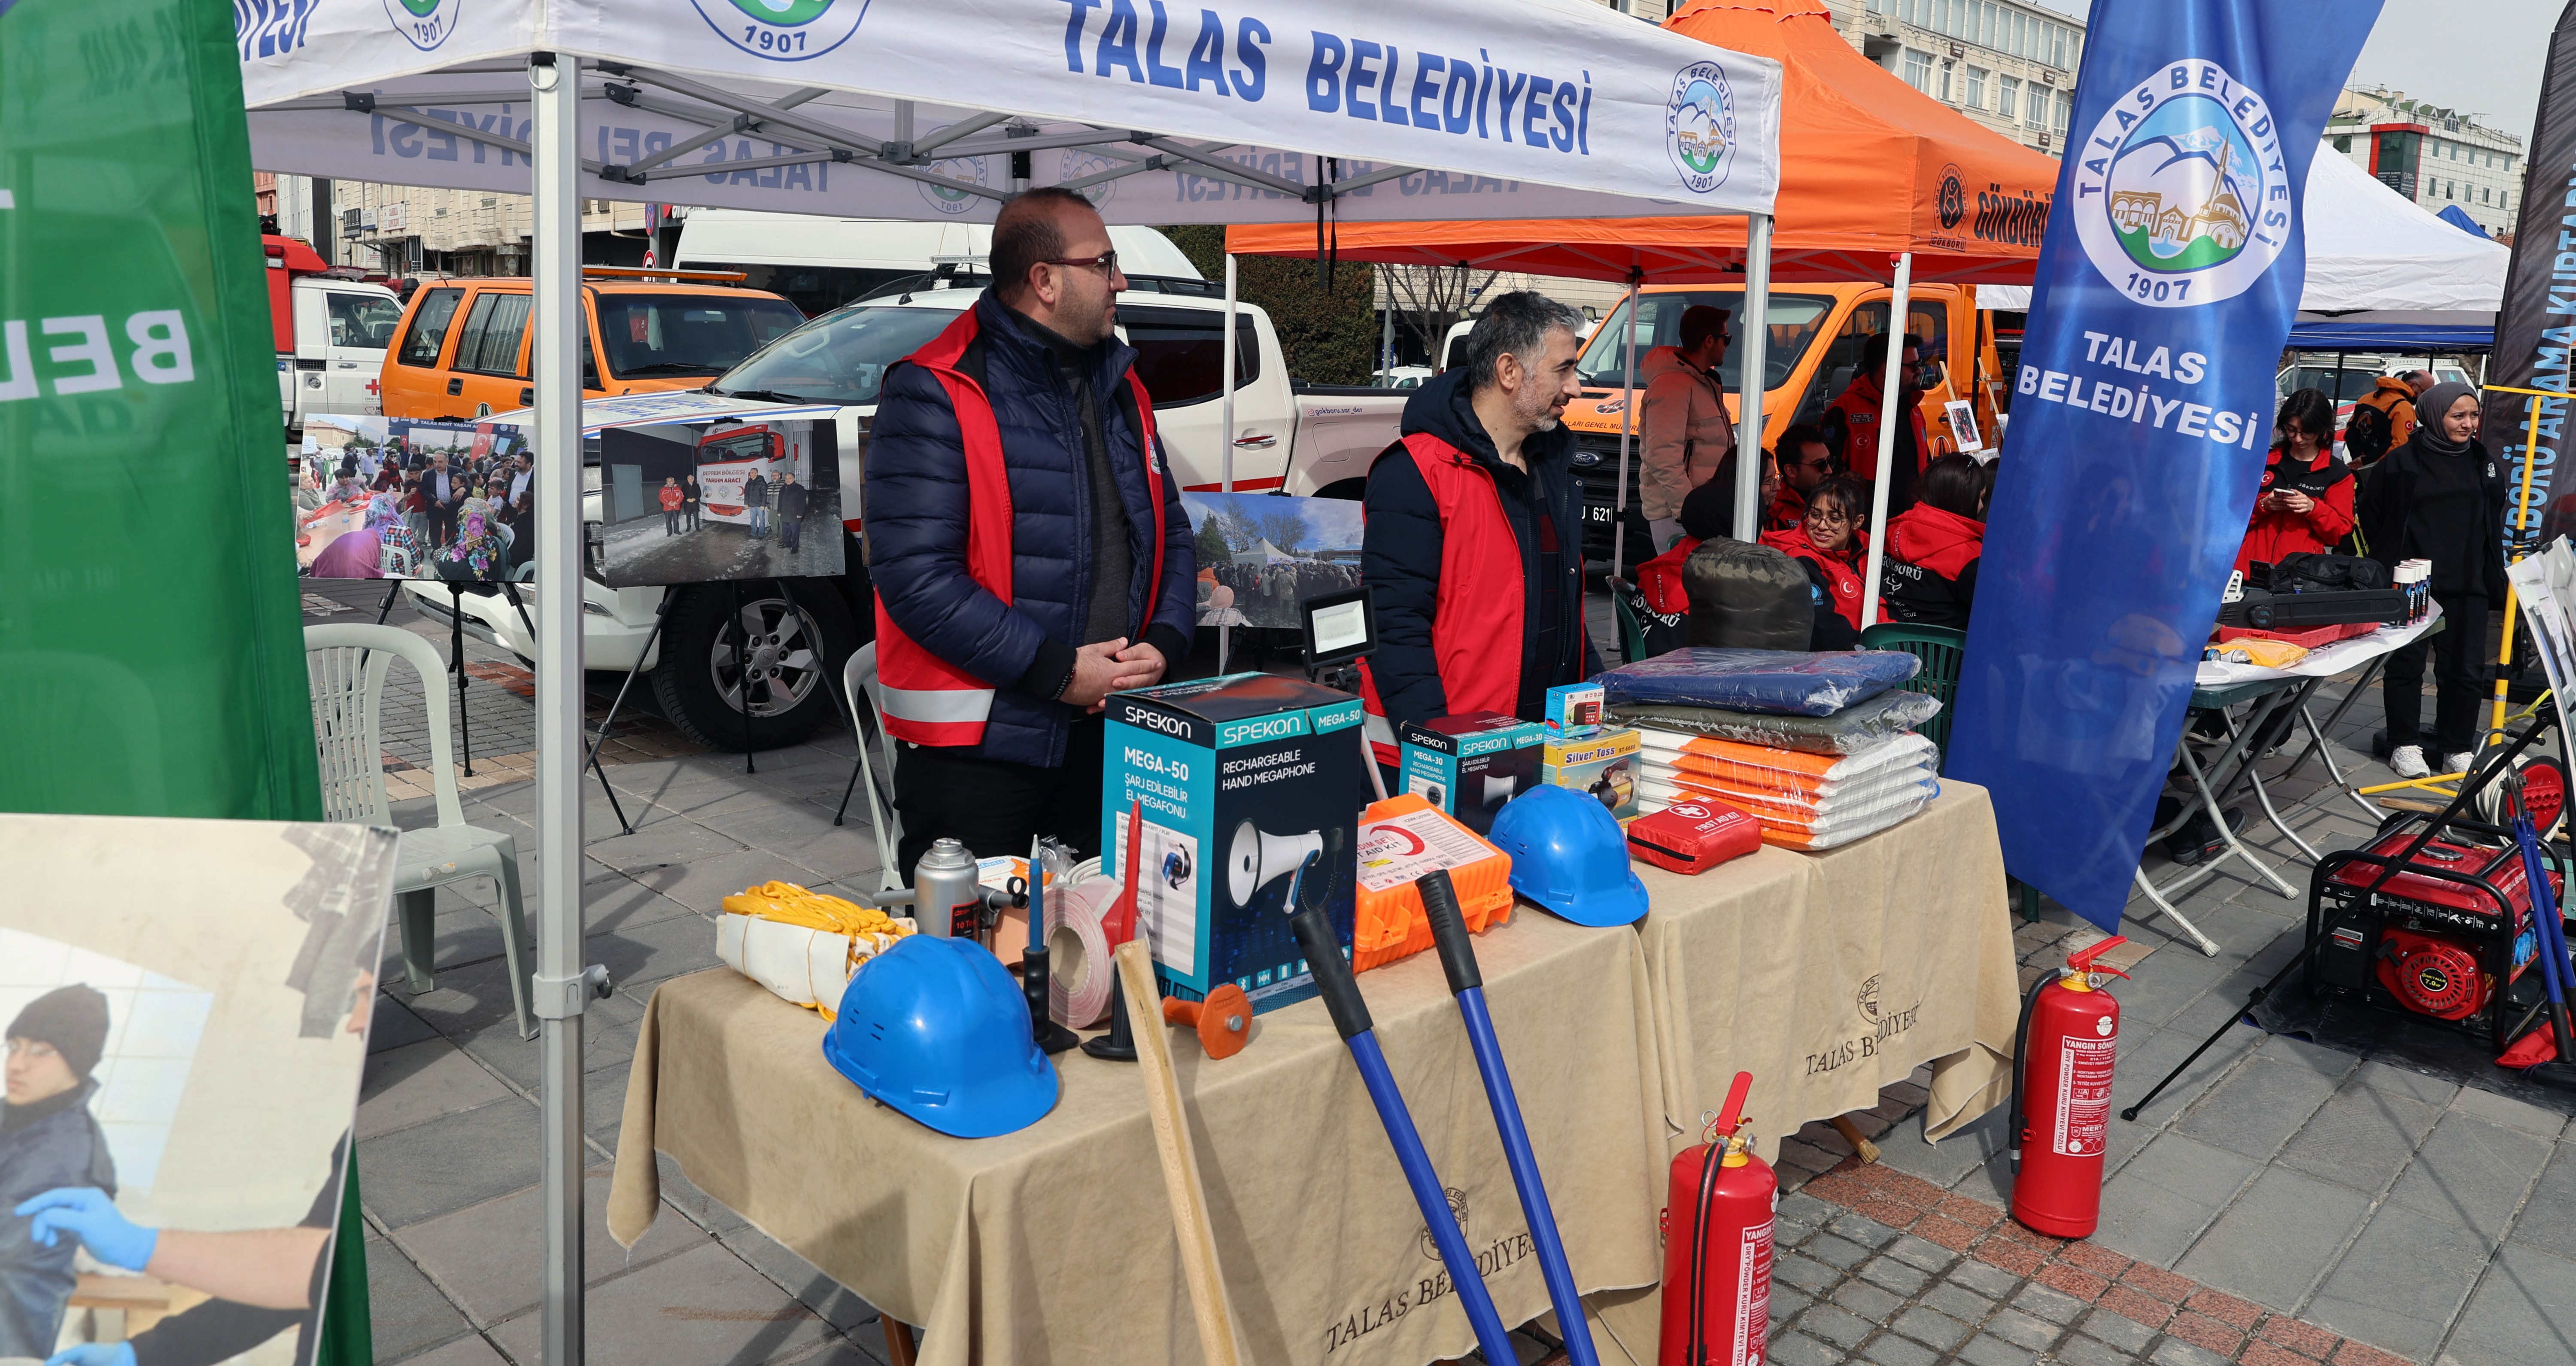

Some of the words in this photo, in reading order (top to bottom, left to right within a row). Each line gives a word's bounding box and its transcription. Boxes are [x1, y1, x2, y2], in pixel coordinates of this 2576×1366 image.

[413, 14, 442, 42] 1907
[744, 25, 807, 53] 1907
[1057, 0, 1272, 102] TALAS
[1306, 30, 1592, 156] BELEDİYESİ
[1669, 78, 1687, 138] TALAS
[1690, 67, 1735, 146] BELEDİYESİ
[2079, 86, 2155, 198] TALAS
[2171, 65, 2287, 249] BELEDİYESİ
[1692, 174, 1713, 189] 1907
[2127, 271, 2192, 302] 1907
[2083, 330, 2207, 384] TALAS
[1315, 406, 1363, 416] gokboru.sar_der
[2018, 364, 2258, 450] BELEDİYESİ
[1574, 453, 1590, 463] Ford
[1593, 507, 1610, 522] 621
[1125, 706, 1191, 739] SPEKON
[1224, 717, 1300, 744] SPEKON
[1318, 709, 1360, 728] MEGA-50
[1411, 733, 1447, 750] SPEKON
[1463, 737, 1507, 755] SPEKON
[1516, 733, 1543, 745] MEGA-30
[1124, 746, 1189, 781] MEGA-50
[1223, 749, 1301, 774] RECHARGEABLE
[1413, 761, 1443, 775] RECHARGEABLE
[1414, 750, 1443, 766] MEGA-30
[1472, 756, 1490, 765] EDİLEBİLİR
[1566, 751, 1593, 764] Silver
[1596, 747, 1615, 758] Toss
[1222, 775, 1252, 791] HAND
[1254, 762, 1316, 785] MEGAPHONE
[1410, 766, 1421, 776] HAND
[1420, 770, 1446, 782] MEGAPHONE
[1467, 764, 1488, 773] MEGAFONU
[1125, 773, 1145, 789] ŞARJ
[1146, 779, 1188, 803] EDİLEBİLİR
[1126, 789, 1135, 802] EL
[1137, 792, 1186, 818] MEGAFONU
[1695, 819, 1716, 831] FIRST
[1717, 814, 1729, 824] AID
[1366, 847, 1384, 857] AID
[1385, 841, 1401, 850] KIT
[956, 921, 965, 929] 10
[2427, 974, 2446, 983] METALLO
[1859, 979, 1875, 1006] TALAS
[1806, 1040, 1854, 1076] TALAS
[1861, 1000, 1919, 1058] BDİYESİ
[2066, 1039, 2096, 1050] YANGIN
[1746, 1227, 1771, 1241] YANGIN
[1742, 1262, 1751, 1292] POWDER
[1326, 1290, 1409, 1354] TALAS
[1417, 1232, 1537, 1306] BEDİYE
